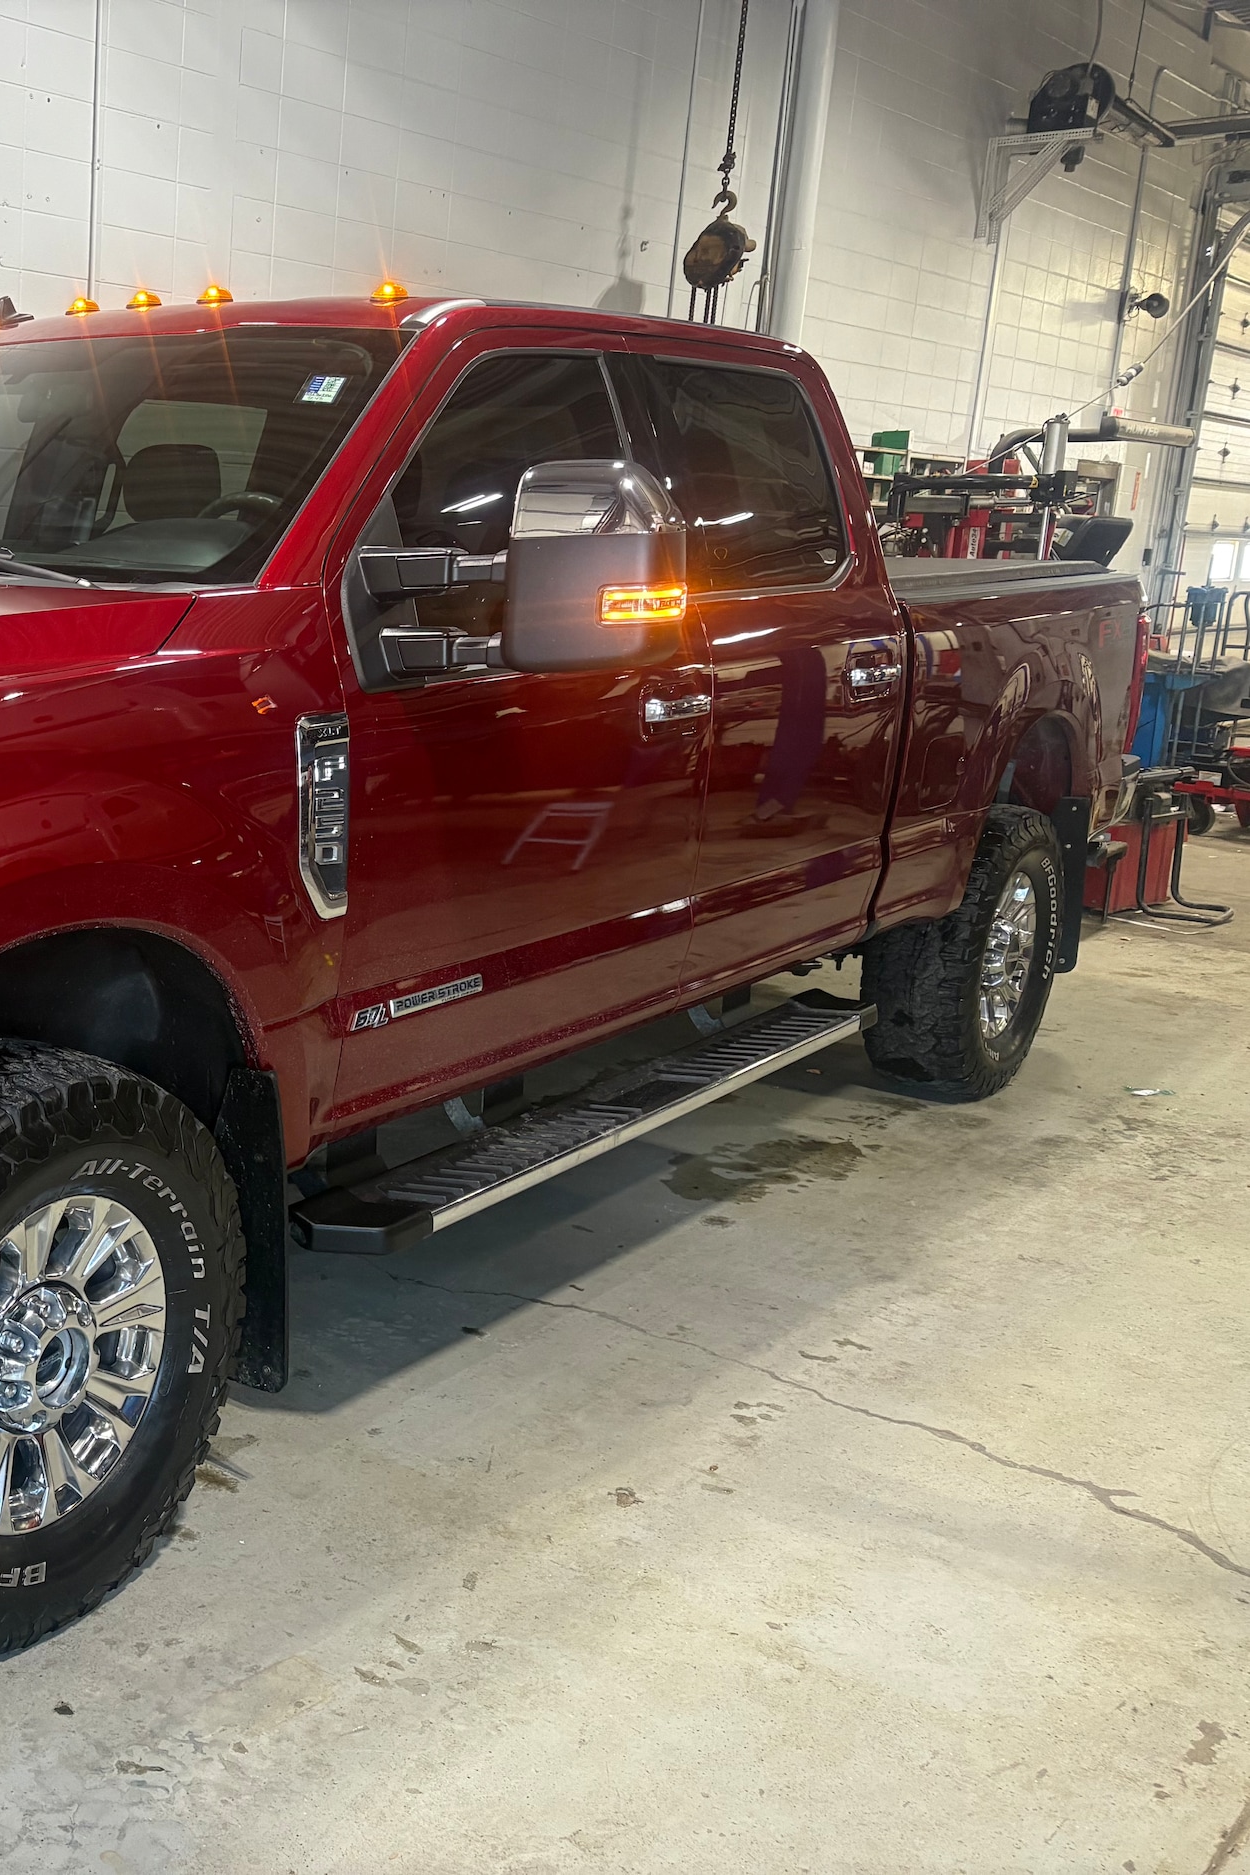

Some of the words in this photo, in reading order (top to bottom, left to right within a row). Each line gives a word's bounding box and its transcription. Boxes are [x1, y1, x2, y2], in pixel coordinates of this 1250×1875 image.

[1099, 619, 1130, 648] FX
[1040, 857, 1058, 980] BFGoodrich
[395, 991, 436, 1011] POWER
[437, 977, 481, 998] STROKE
[70, 1158, 206, 1279] All-Terrain
[186, 1303, 211, 1374] T/A
